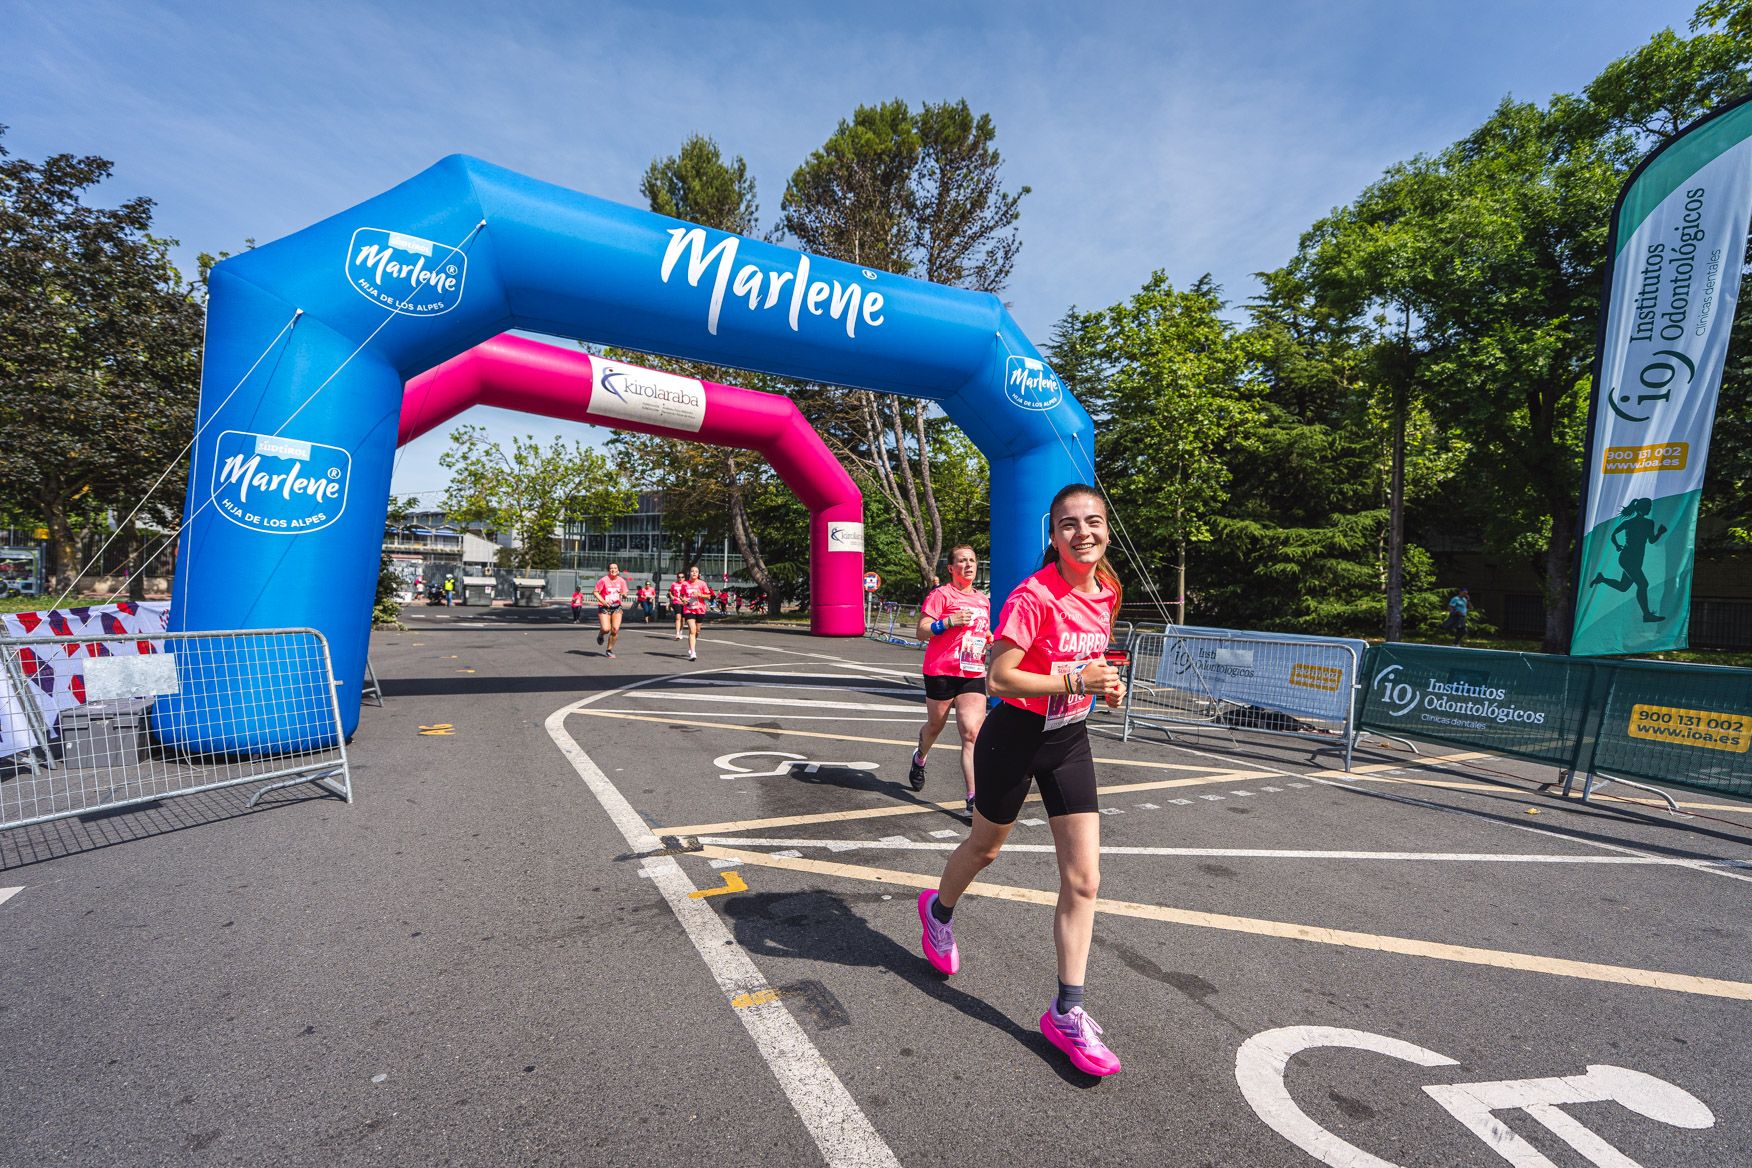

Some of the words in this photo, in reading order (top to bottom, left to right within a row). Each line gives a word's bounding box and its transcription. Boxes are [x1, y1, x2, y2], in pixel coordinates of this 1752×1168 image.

[355, 244, 456, 294] Marlene
[1660, 187, 1705, 341] Odontológicos
[358, 278, 378, 297] HIJA
[380, 295, 393, 305] DE
[396, 301, 414, 311] LOS
[416, 301, 444, 311] ALPES
[661, 227, 884, 338] Marlene
[1629, 243, 1665, 343] Institutos
[1695, 297, 1712, 337] Clínicas
[1706, 249, 1721, 295] dentales
[624, 378, 699, 407] kirolaraba
[1010, 367, 1058, 395] Marlene
[1606, 458, 1680, 470] www.ioa.es
[1607, 450, 1633, 460] 900
[1654, 447, 1682, 457] 002
[220, 453, 339, 503] Marlene
[222, 498, 242, 517] HIJA
[244, 513, 261, 525] DE
[263, 518, 287, 528] LOS
[290, 512, 327, 528] ALPES
[1426, 678, 1506, 701] Institutos
[1424, 695, 1545, 724] Odontológicos
[1450, 717, 1487, 731] dentales
[1639, 710, 1672, 724] 900
[1677, 714, 1702, 728] 131
[1707, 718, 1744, 733] 002
[1637, 723, 1741, 746] www.ioa.es
